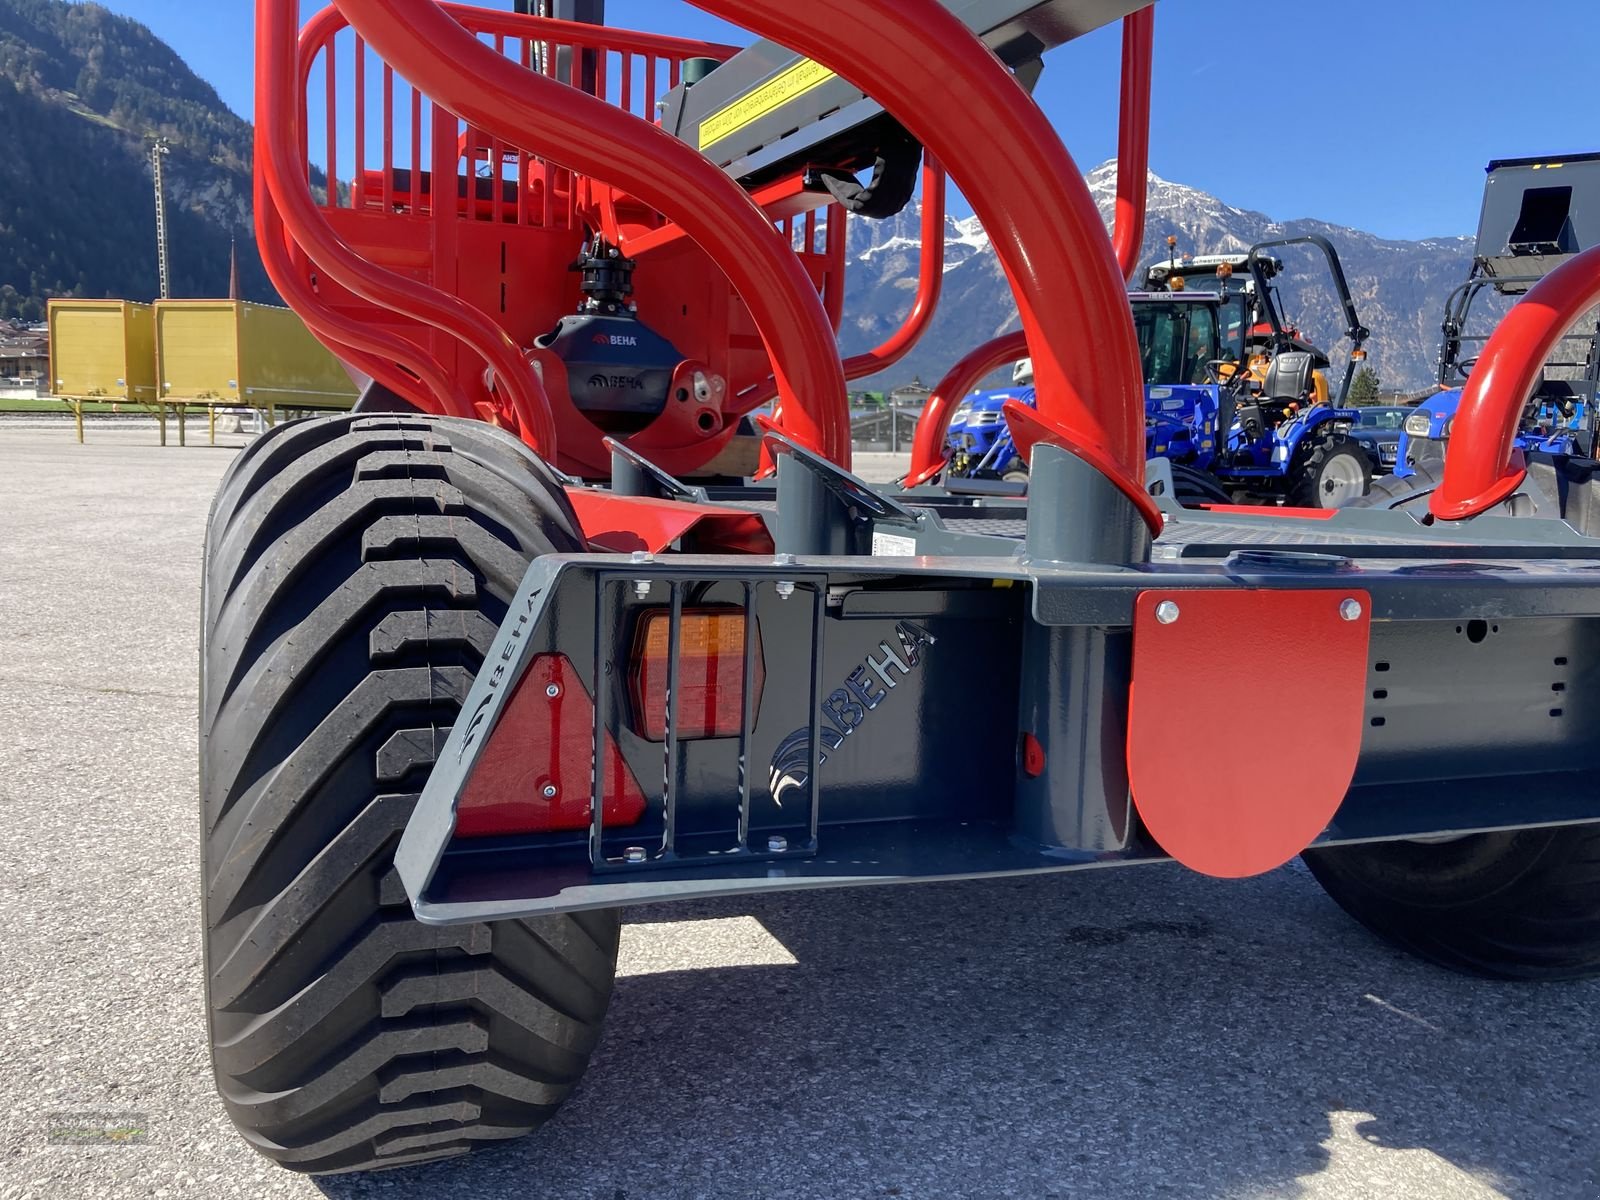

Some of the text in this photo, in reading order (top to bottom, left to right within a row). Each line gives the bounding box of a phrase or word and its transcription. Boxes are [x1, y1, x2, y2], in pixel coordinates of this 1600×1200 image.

[610, 335, 637, 346] BEHA
[610, 376, 644, 390] BEHA
[488, 588, 543, 690] BEHA
[821, 619, 938, 737] BEHA
